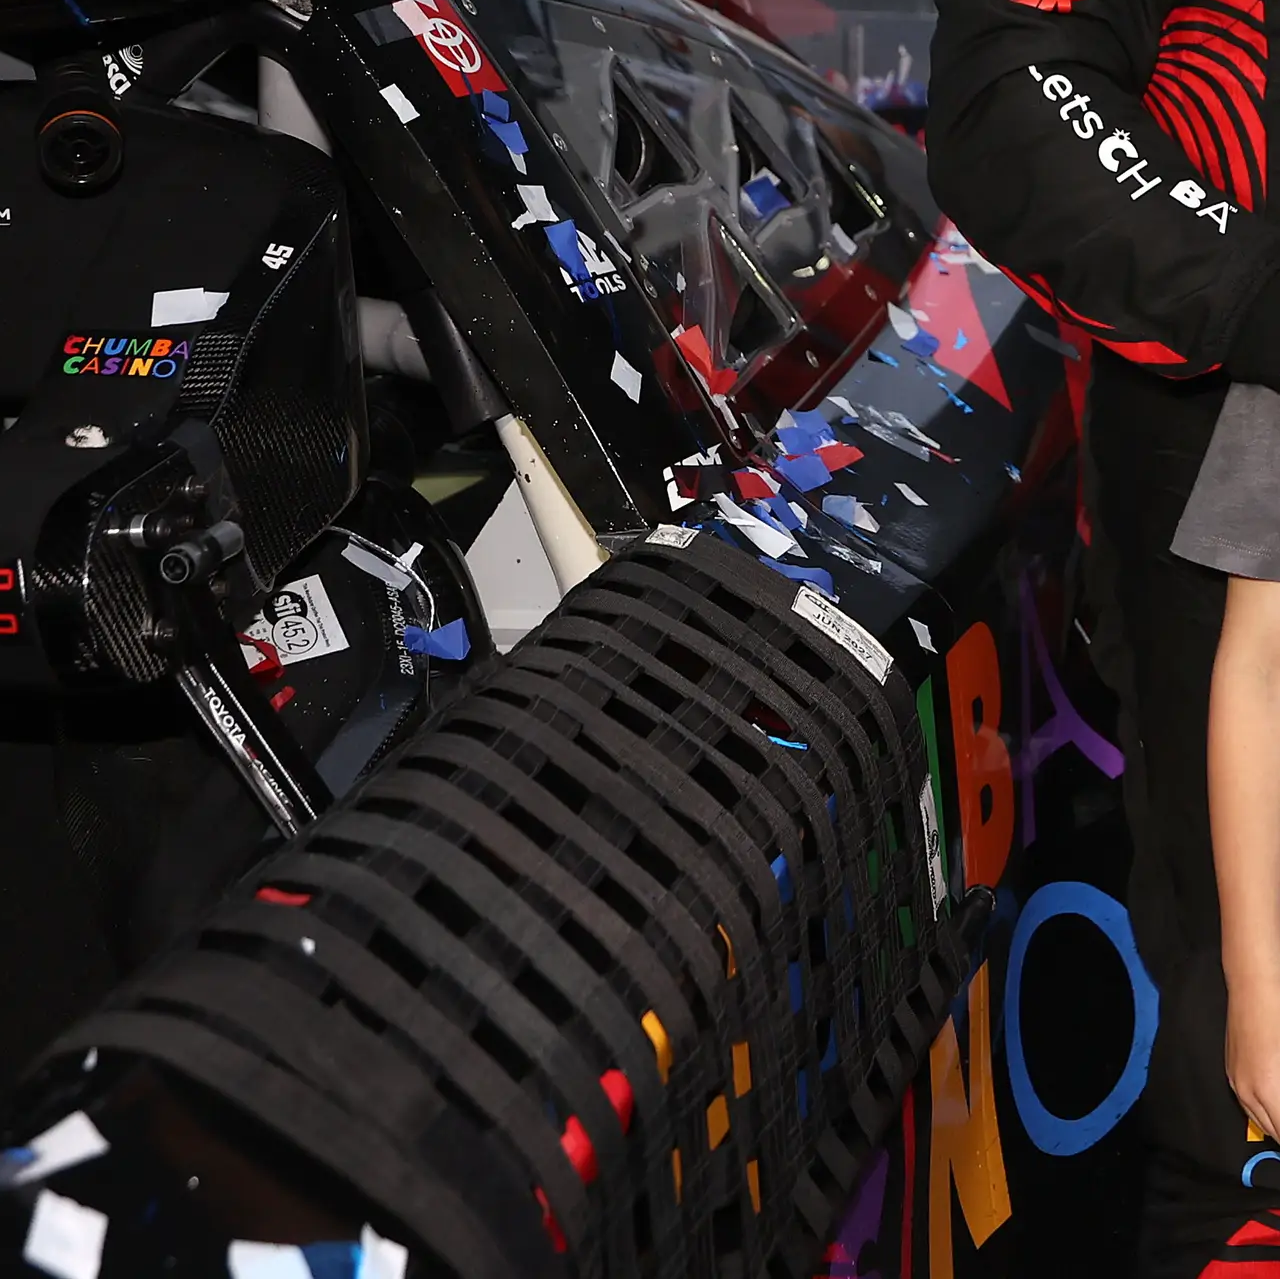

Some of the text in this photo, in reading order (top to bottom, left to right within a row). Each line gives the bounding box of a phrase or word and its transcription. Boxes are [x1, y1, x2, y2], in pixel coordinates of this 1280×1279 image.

[261, 242, 295, 270] 45
[63, 334, 194, 360] CHUMBA
[63, 356, 177, 379] CASINO
[273, 594, 311, 652] sfi 45.2
[812, 612, 841, 634] JUN
[843, 634, 873, 660] 2027
[203, 687, 247, 746] TOYOTA
